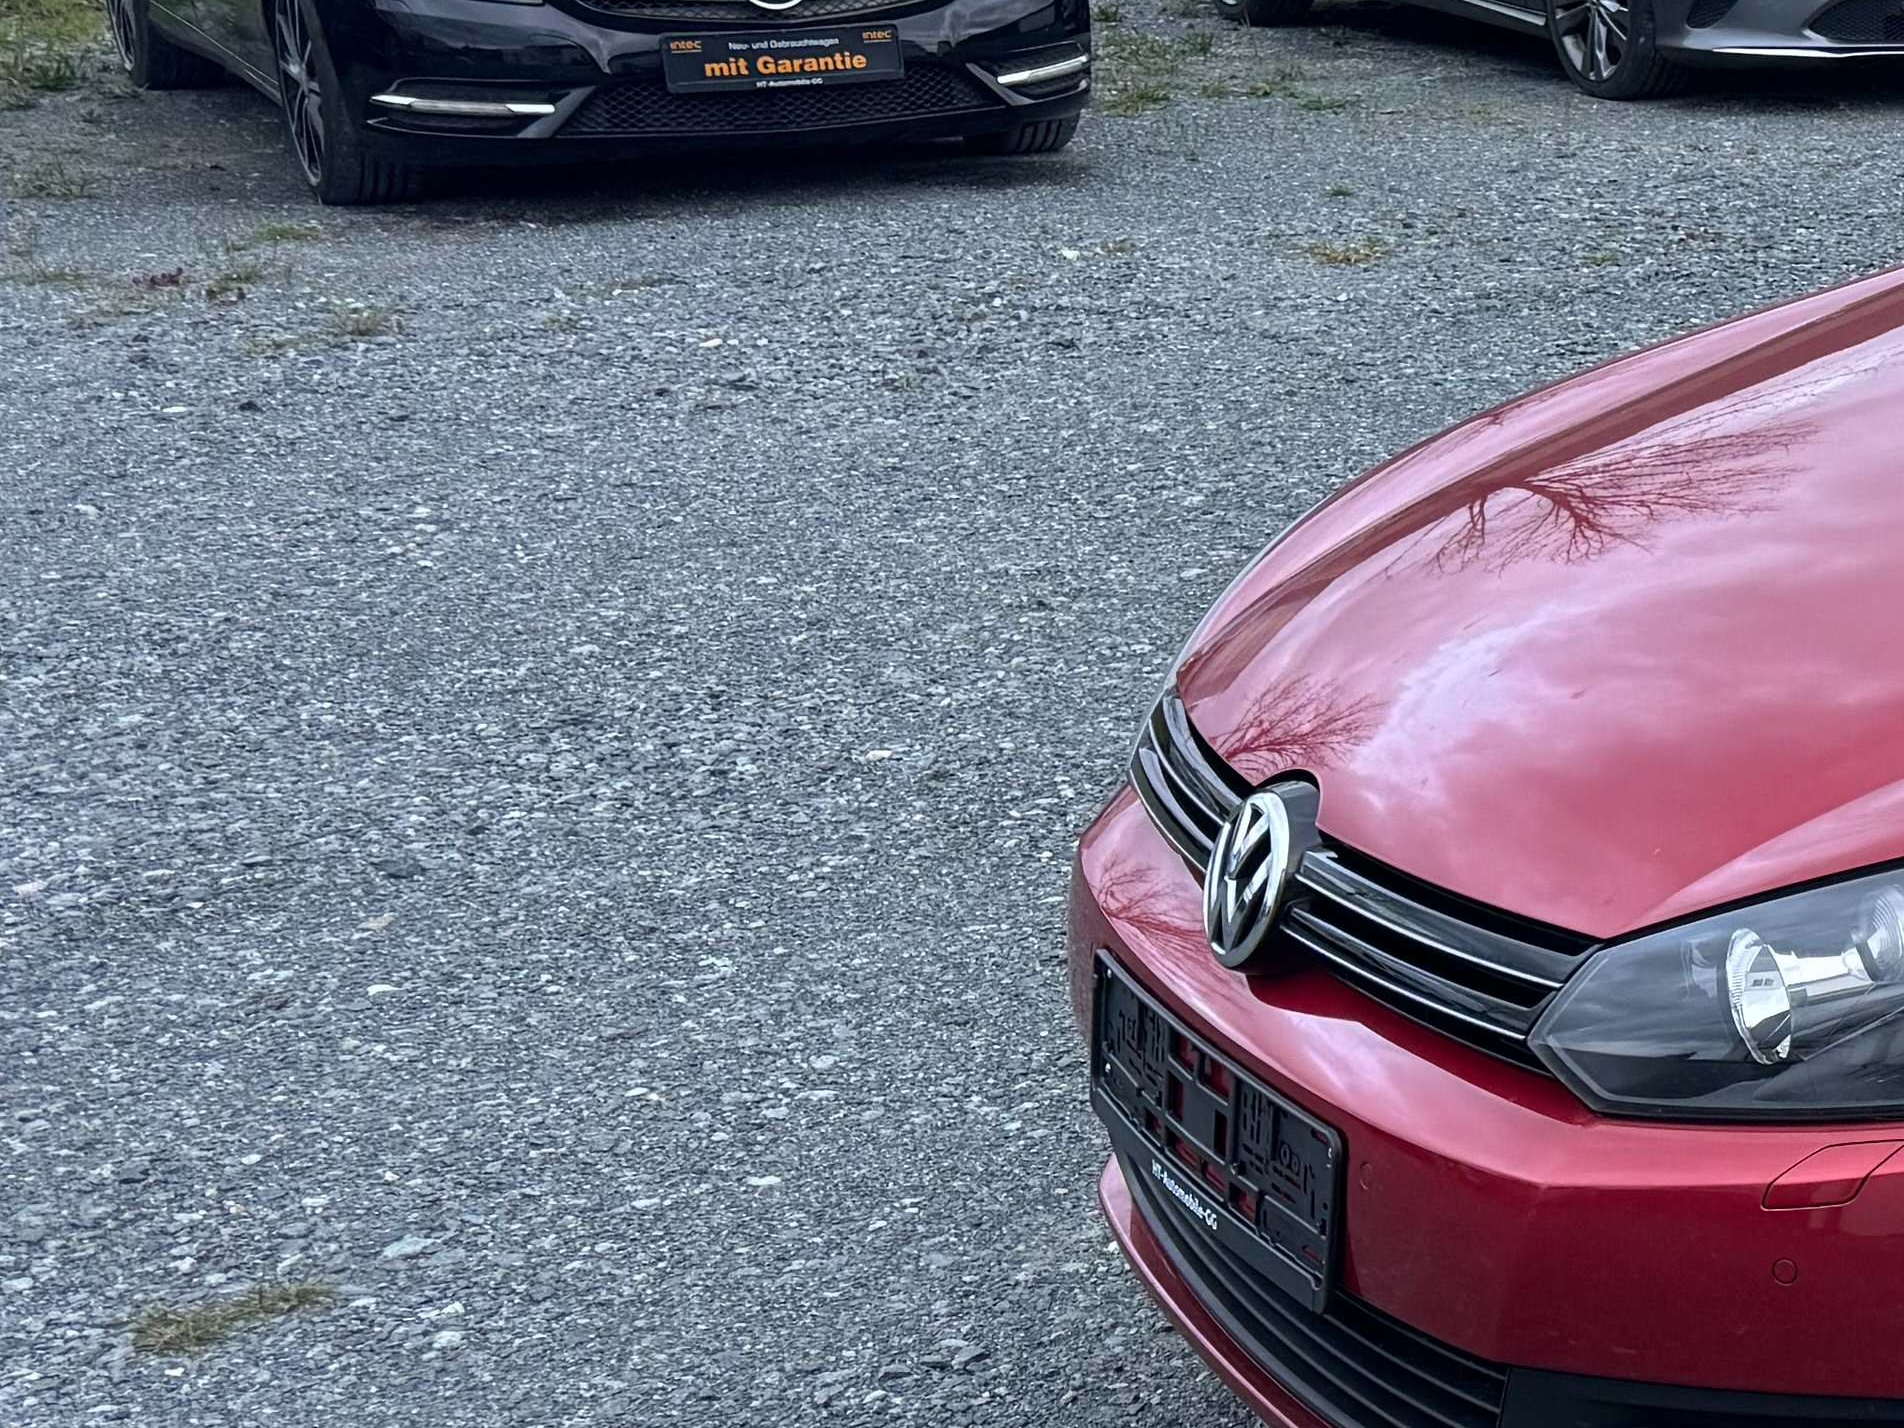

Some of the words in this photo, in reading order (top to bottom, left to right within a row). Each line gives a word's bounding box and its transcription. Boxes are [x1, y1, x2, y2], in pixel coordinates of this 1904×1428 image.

[751, 40, 769, 50] und
[704, 57, 750, 77] mit
[756, 52, 868, 76] Garantie
